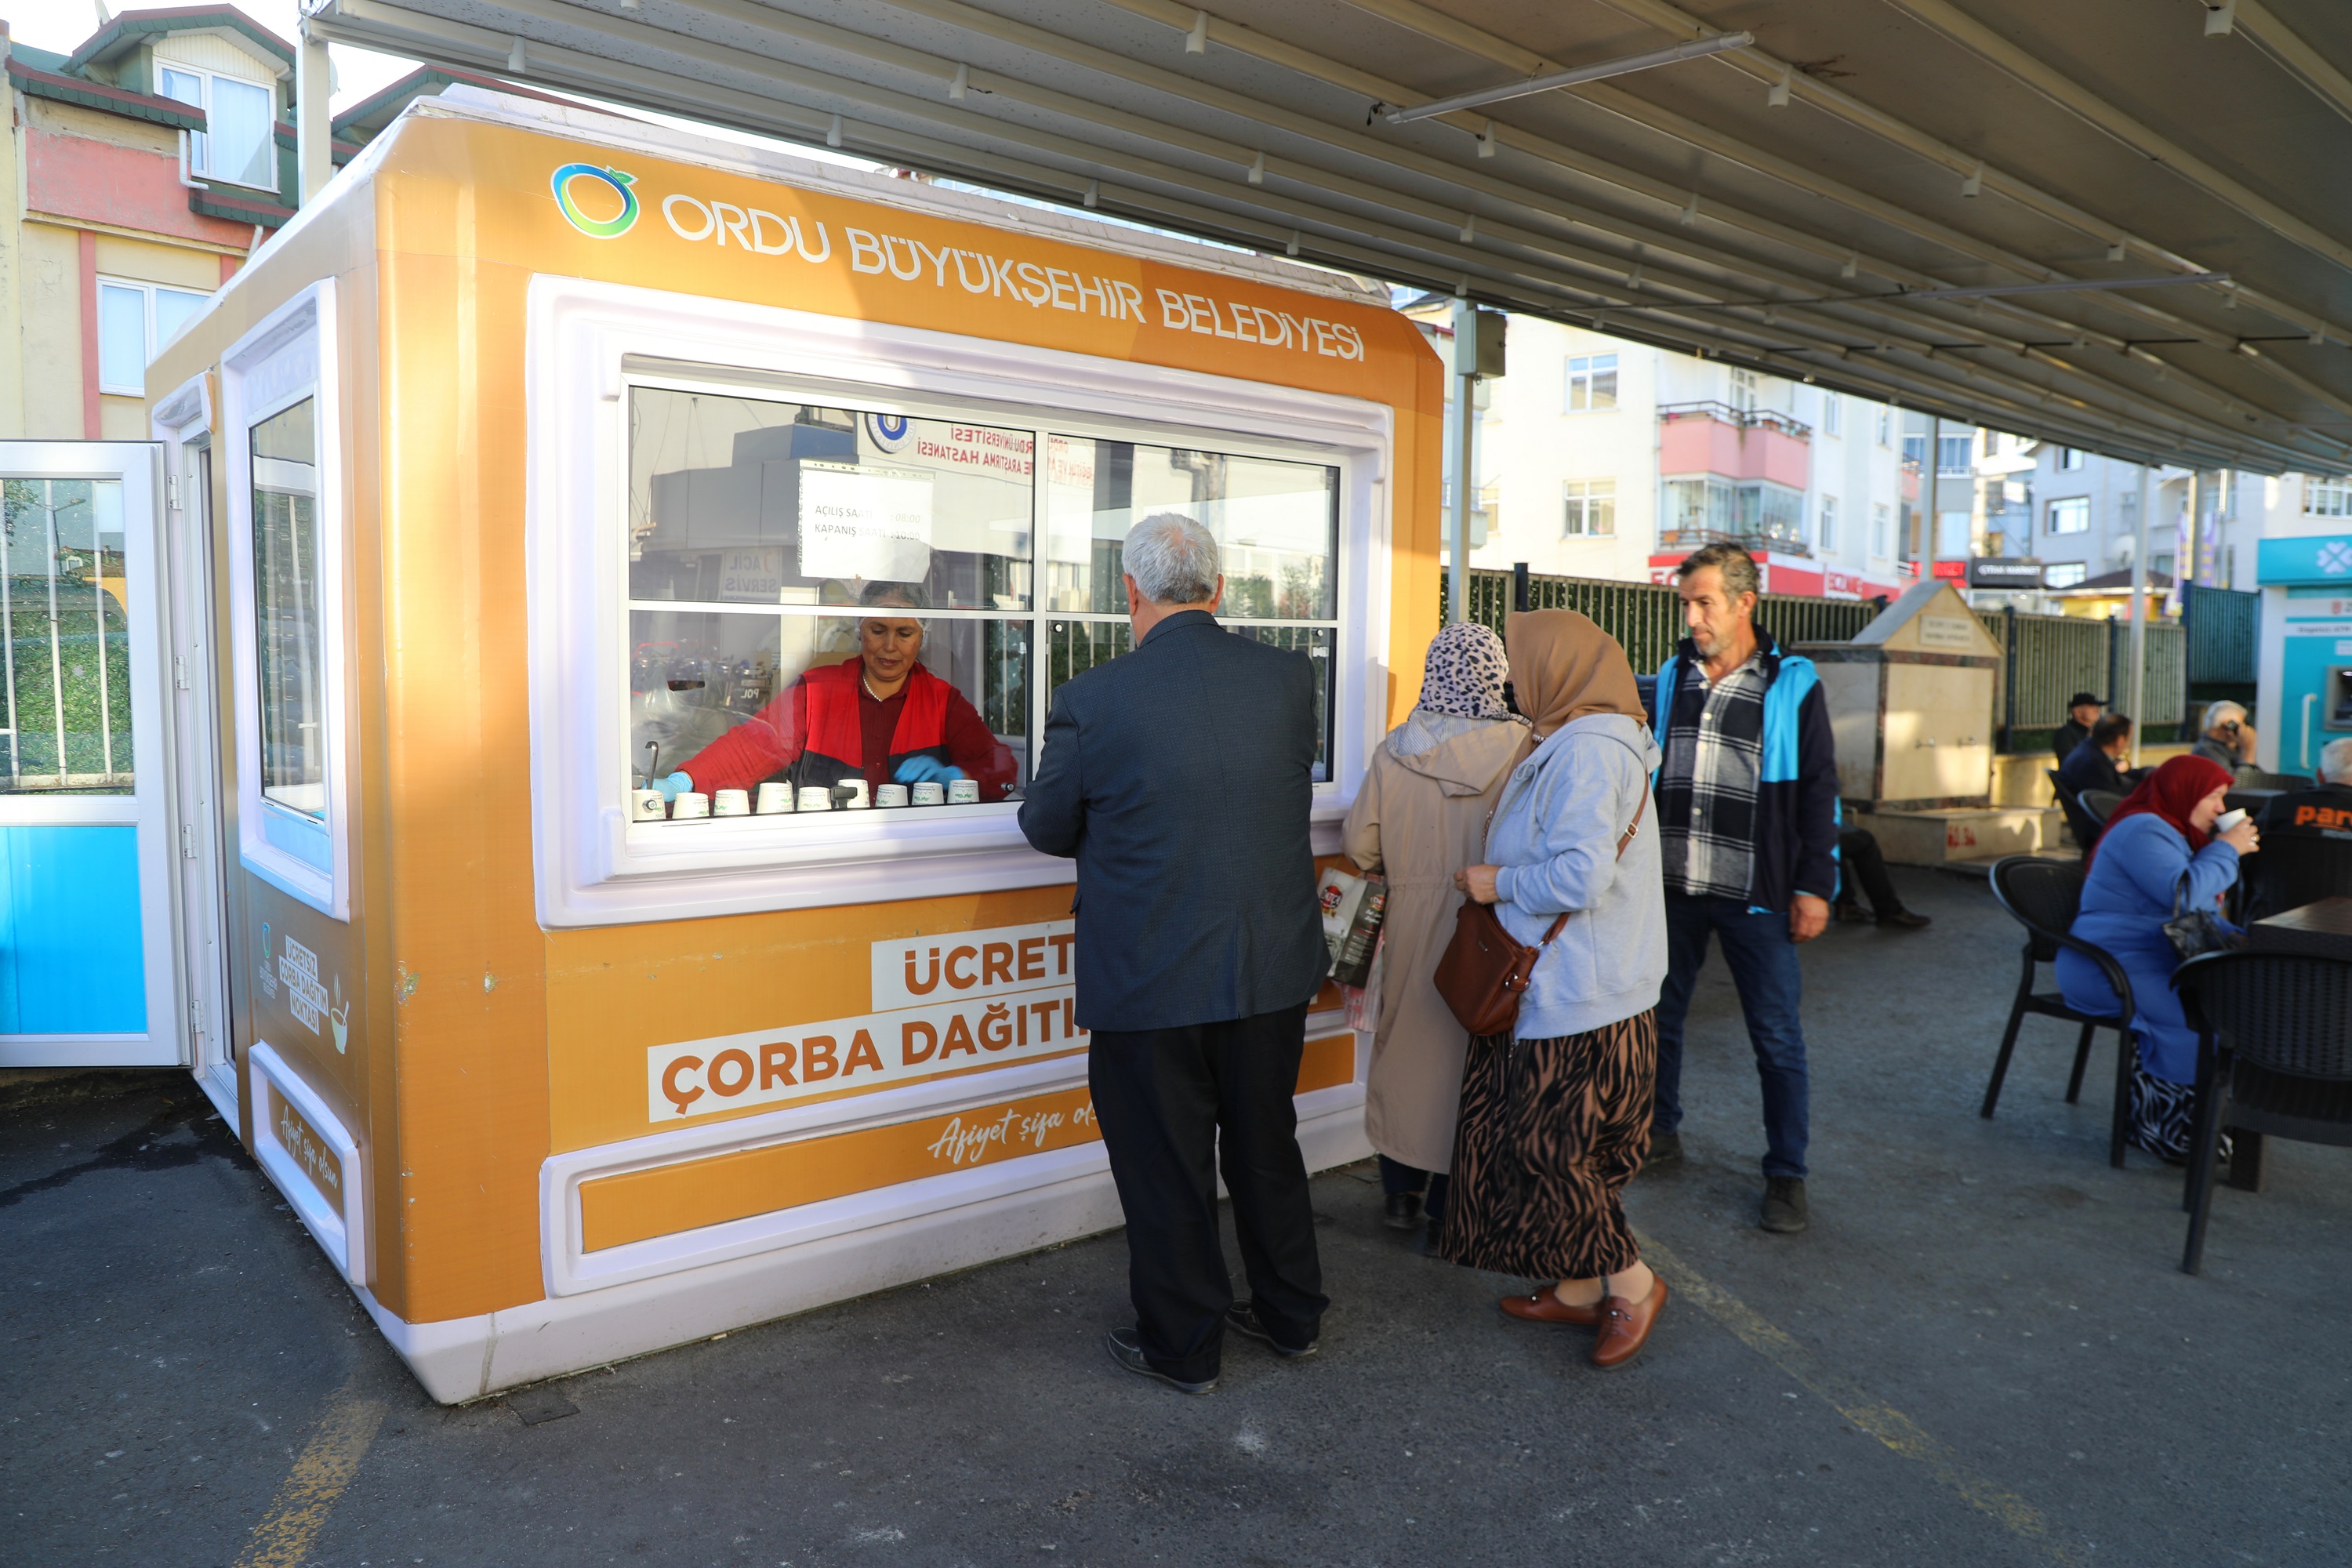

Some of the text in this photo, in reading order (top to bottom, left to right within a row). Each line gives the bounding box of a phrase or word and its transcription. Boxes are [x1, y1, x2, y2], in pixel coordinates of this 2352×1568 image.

[662, 194, 1365, 362] ORDU BÜYÜKŞEHİR BELEDİYESİ
[815, 506, 844, 518] AÇILIŞ
[846, 508, 873, 519] SAATİ
[815, 524, 856, 538] KAPANIŞ
[859, 526, 886, 539] SAATİ
[895, 531, 920, 540] 10:00
[281, 960, 327, 1010] ÇORBA DAĞITIM
[905, 933, 1075, 996] ÜCRET
[292, 996, 318, 1031] NOKTASI
[661, 998, 1088, 1115] ÇORBA DAĞITI
[281, 1105, 338, 1189] Afiyet şifa olsun
[927, 1108, 1019, 1166] Afiyet
[1020, 1112, 1065, 1148] şifa
